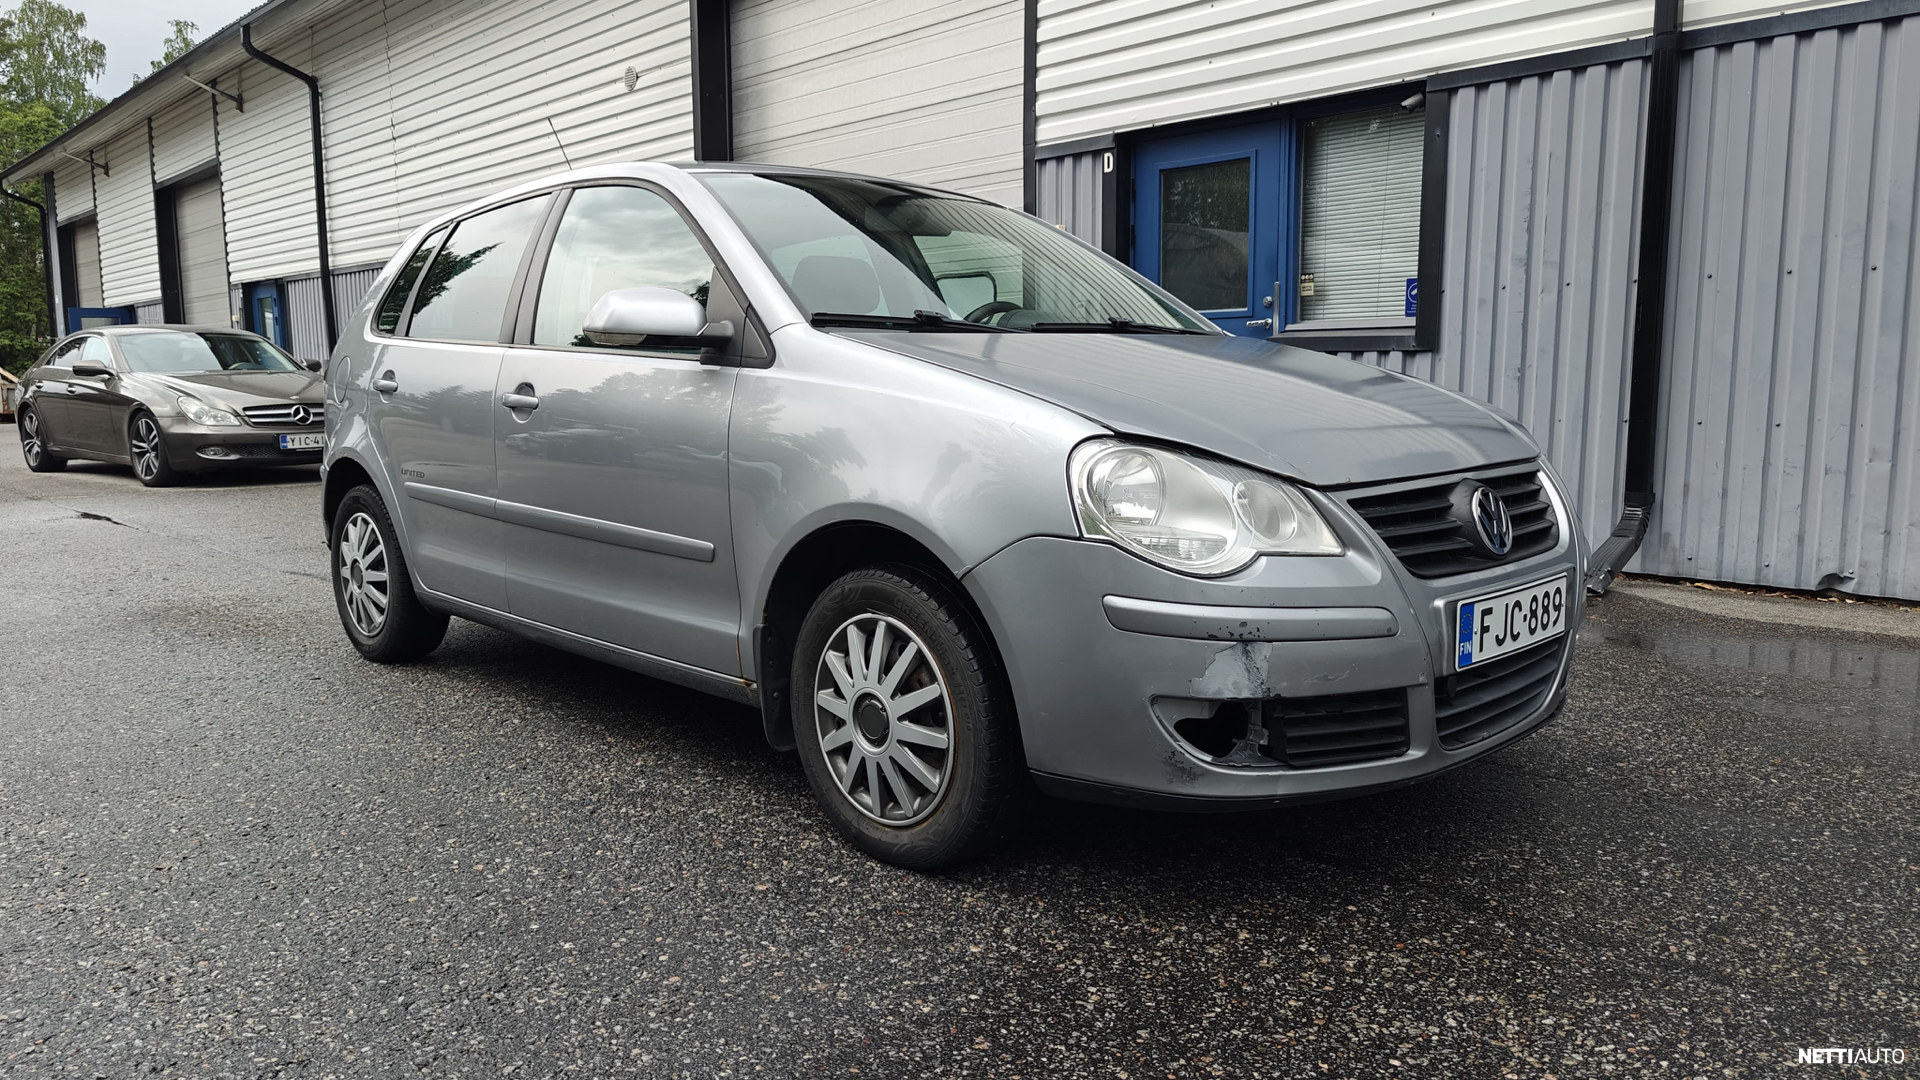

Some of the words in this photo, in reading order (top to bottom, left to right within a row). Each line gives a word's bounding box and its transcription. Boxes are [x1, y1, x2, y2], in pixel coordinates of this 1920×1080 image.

[1103, 152, 1114, 173] D
[401, 467, 425, 479] UNITED
[1479, 586, 1562, 653] FJC-889
[1459, 641, 1472, 656] FIN
